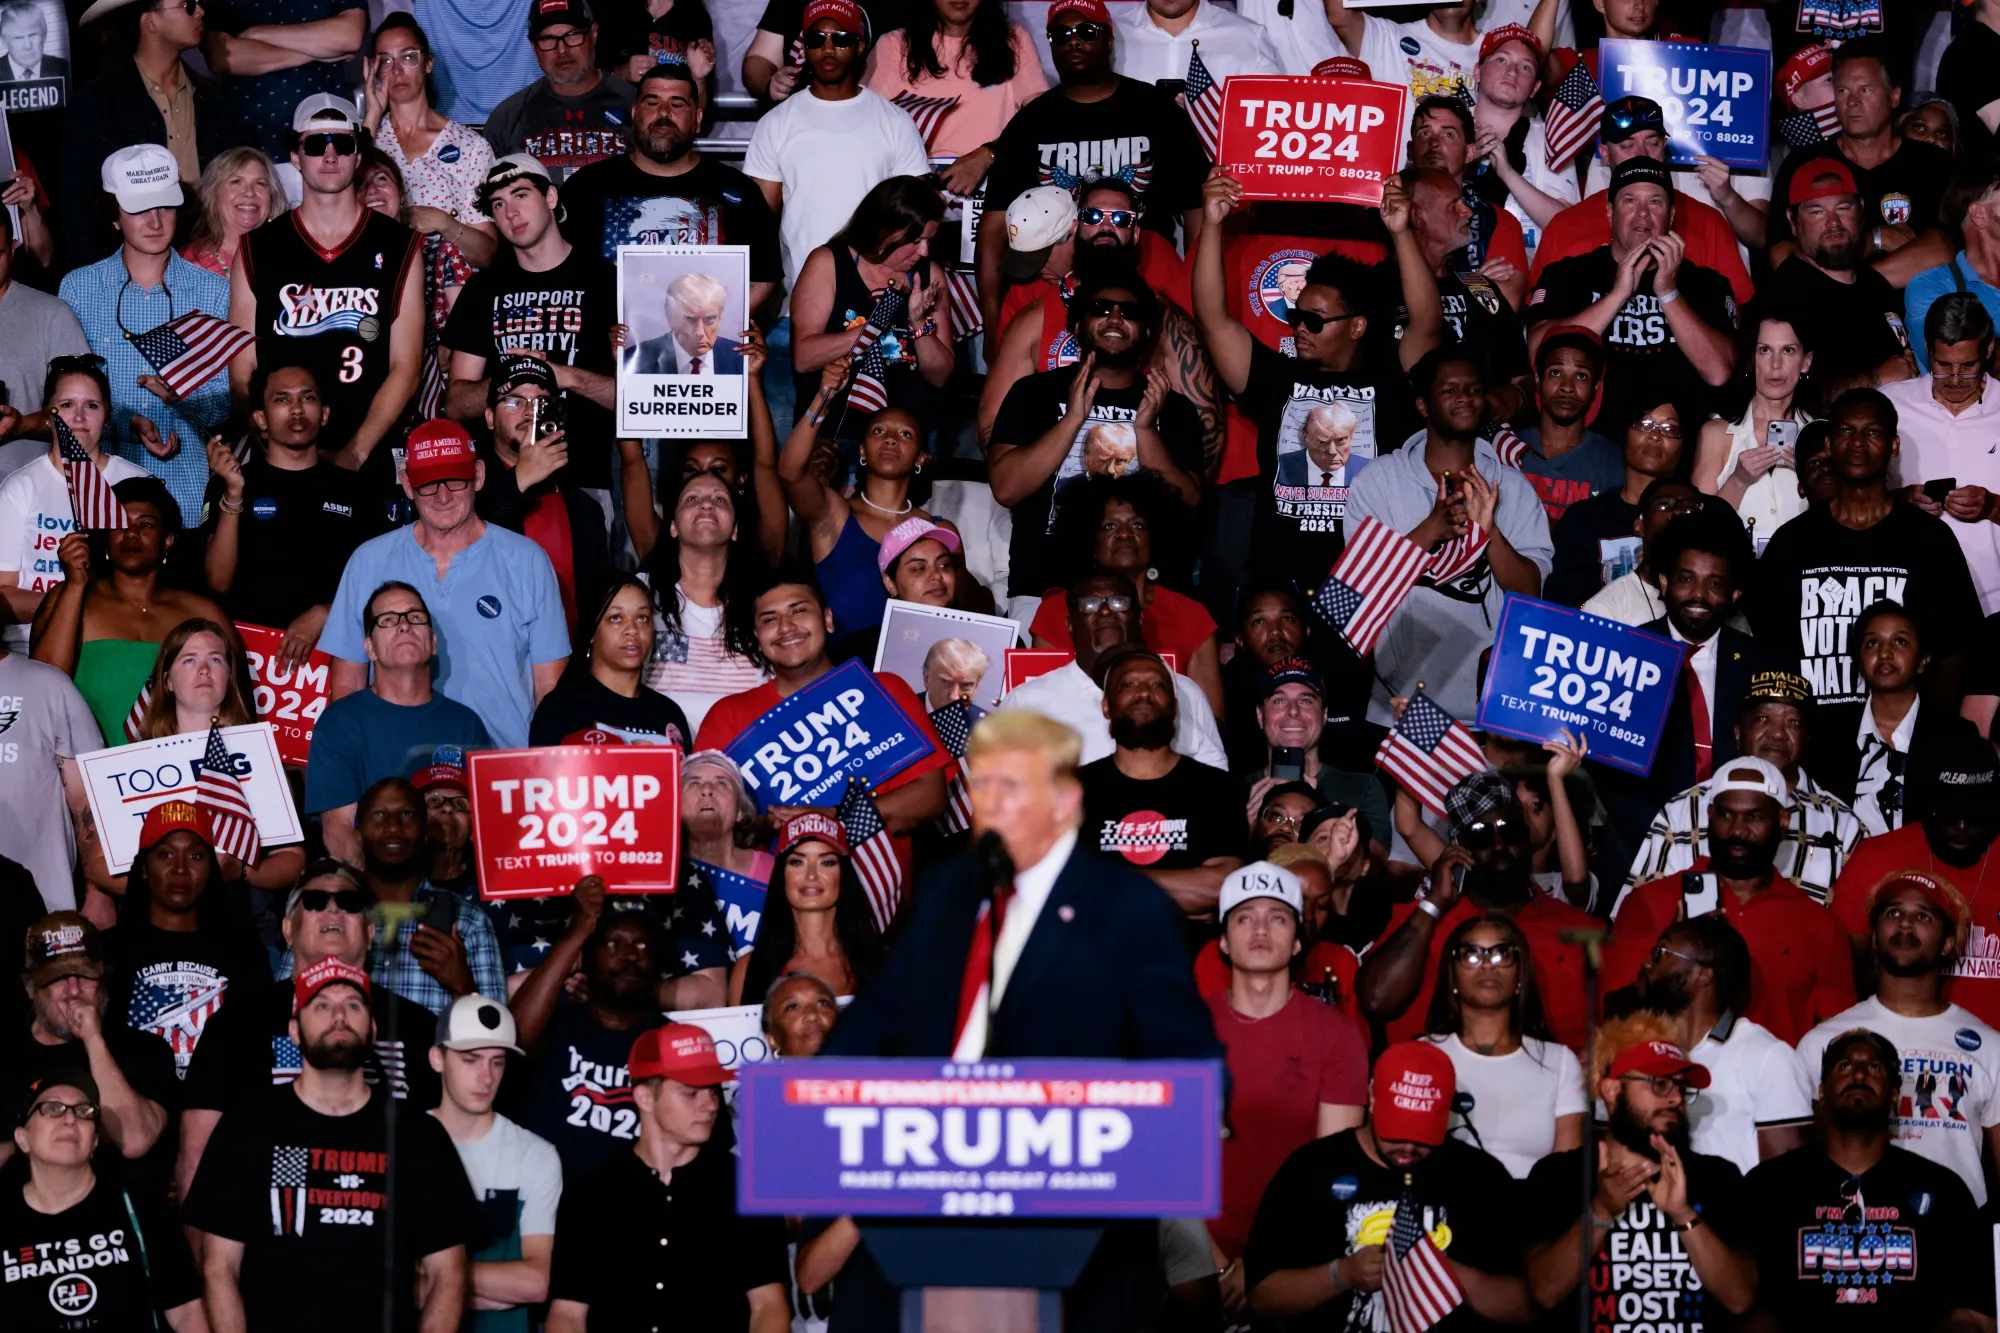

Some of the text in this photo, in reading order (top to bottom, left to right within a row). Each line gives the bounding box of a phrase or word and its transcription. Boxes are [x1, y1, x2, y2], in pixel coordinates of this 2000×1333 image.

[831, 4, 852, 18] AGAIN
[1617, 65, 1754, 104] TRUMP
[4, 86, 60, 110] LEGEND
[1239, 100, 1386, 134] TRUMP
[1661, 98, 1735, 128] 024
[525, 131, 627, 157] MARINES
[1254, 130, 1360, 162] 2024
[1696, 131, 1712, 142] TO
[1716, 132, 1755, 146] 88022
[1037, 136, 1151, 179] TRUMP
[126, 165, 171, 178] MAKE AMERICA
[130, 173, 171, 185] GREAT AGAIN
[1231, 163, 1382, 181] TEXT TRUMP TO 88022
[1882, 200, 1910, 209] TRUMP
[679, 229, 699, 246] 24
[1248, 249, 1322, 317] THE MAGA MOVEM
[503, 289, 585, 309] SUPPORT
[1609, 314, 1676, 346] IRS
[340, 346, 364, 384] 3
[509, 362, 547, 374] TRUMP
[654, 384, 714, 398] NEVER
[1293, 382, 1376, 401] WANTED
[628, 401, 738, 416] SURRENDER
[414, 437, 463, 451] MAKE AMERICA
[416, 447, 463, 461] GREAT AGAIN
[1274, 485, 1349, 501] NEVER SURREN
[1276, 502, 1345, 517] OR PRESID
[1300, 519, 1335, 533] 2024
[33, 558, 64, 574] an
[1800, 616, 1857, 657] VOT
[1267, 656, 1314, 676] TRUMP
[1519, 625, 1662, 692] TRUMP
[246, 650, 328, 693] RUM
[1751, 671, 1809, 690] LOYALTY
[1800, 656, 1865, 696] MAT
[1529, 665, 1632, 723] 2024
[1776, 680, 1787, 689] IS
[252, 686, 328, 728] 024
[1500, 694, 1646, 747] TEXT TRUMP TO 88022
[281, 724, 303, 739] TO
[740, 688, 867, 791] TRUMP
[769, 719, 872, 803] 2024
[800, 731, 906, 806] TRUMP TO 88022
[107, 764, 182, 797] TOO
[491, 773, 661, 815] TRUMP
[161, 812, 197, 825] MAGA
[518, 811, 639, 850] 2024
[494, 850, 663, 870] TEXT TRUMP TO 88022
[1242, 874, 1285, 895] USA
[136, 960, 219, 980] I CARRY BECAUSE
[162, 973, 209, 985] TOO YOUNG
[715, 1037, 767, 1067] OO
[568, 1045, 633, 1088] Trum
[1388, 1081, 1442, 1100] AMERICA
[1393, 1095, 1434, 1112] GREAT
[567, 1094, 640, 1139] 202
[1910, 1118, 1941, 1129] GREAT
[824, 1107, 1133, 1167] TRUMP
[319, 1208, 374, 1225] 2024
[1865, 1206, 1900, 1221] TING
[1601, 1230, 1689, 1262] EALL
[1803, 1232, 1914, 1271] FELON
[5, 1247, 130, 1283] BRANDON
[1592, 1290, 1682, 1324] MOST
